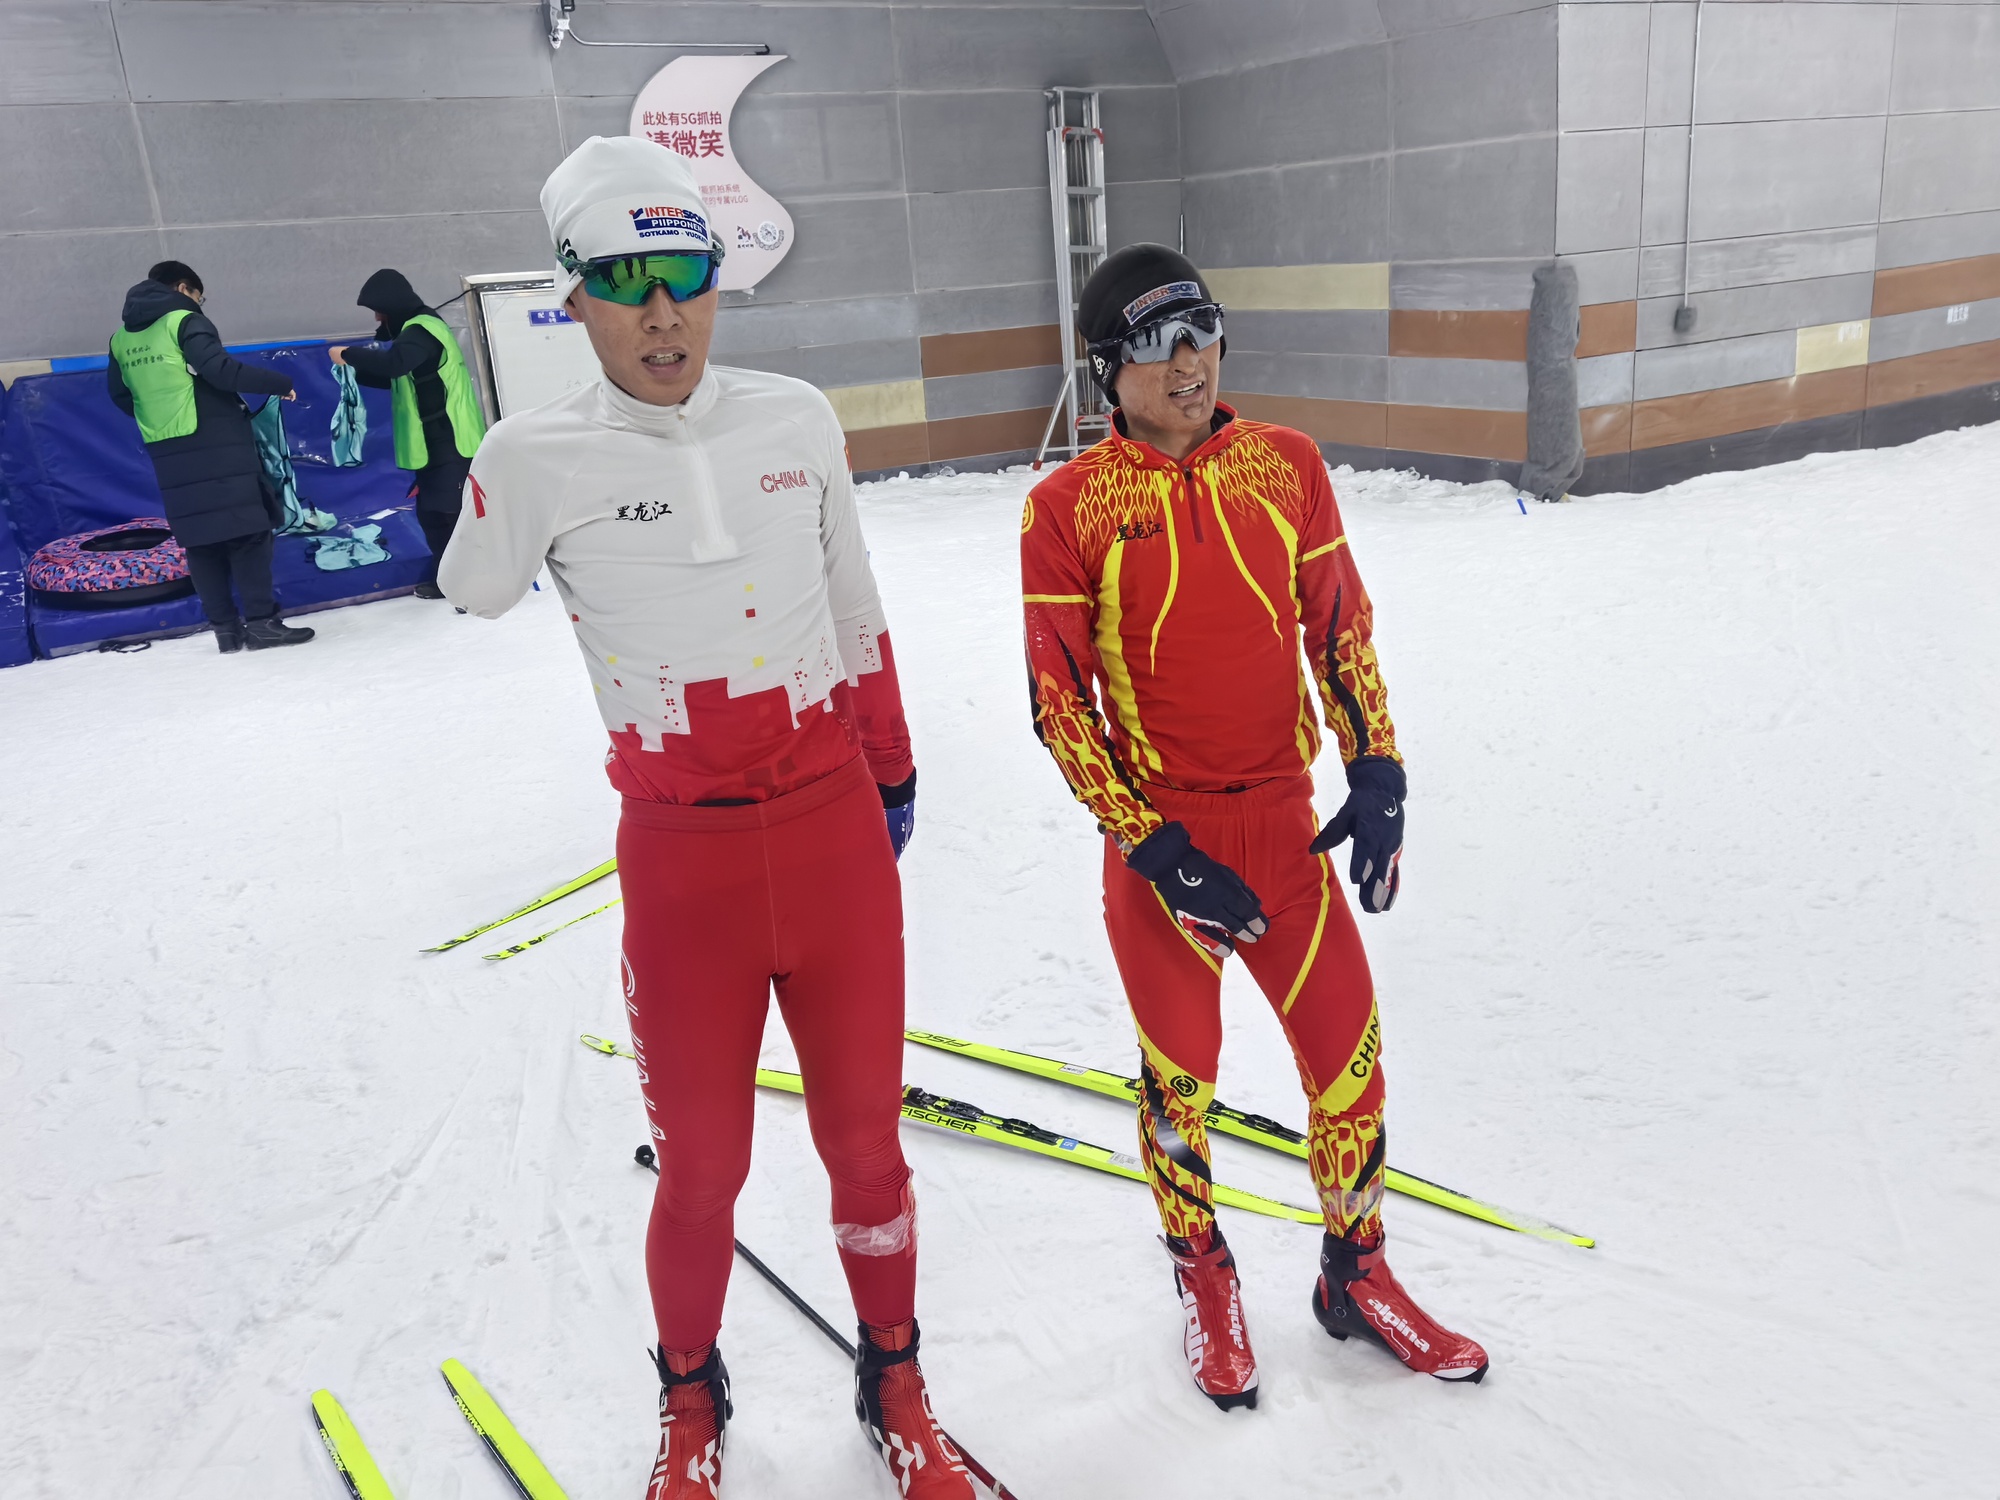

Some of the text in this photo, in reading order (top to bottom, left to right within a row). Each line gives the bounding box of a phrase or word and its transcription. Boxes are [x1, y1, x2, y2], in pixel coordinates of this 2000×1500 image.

[642, 111, 722, 126] 此处有5G抓拍
[645, 129, 724, 158] 请微笑
[639, 229, 680, 239] SOTKAMO
[760, 469, 810, 494] CHINA
[614, 500, 673, 522] 黑龙江
[1116, 520, 1164, 543] 黑龙江
[1350, 1000, 1379, 1078] CHIN
[1229, 1279, 1245, 1350] alpina
[1367, 1298, 1431, 1353] alpina
